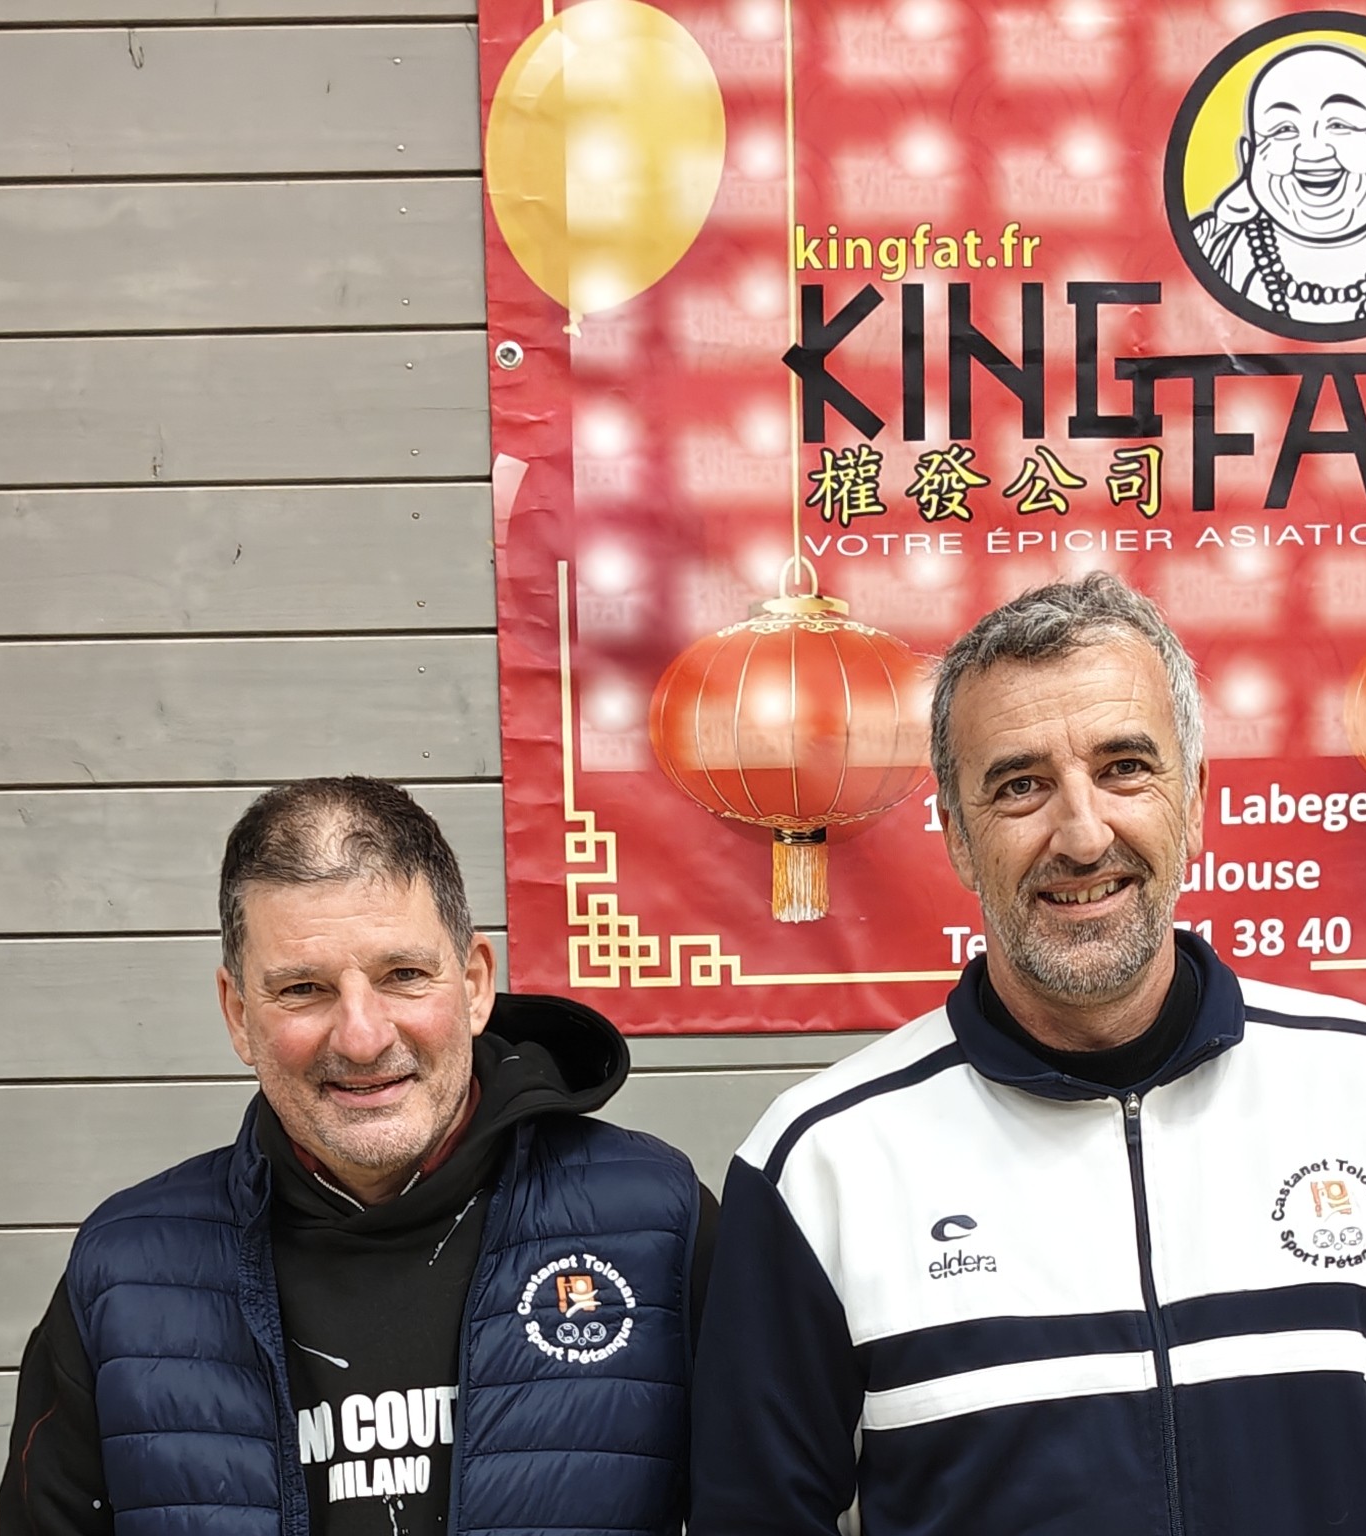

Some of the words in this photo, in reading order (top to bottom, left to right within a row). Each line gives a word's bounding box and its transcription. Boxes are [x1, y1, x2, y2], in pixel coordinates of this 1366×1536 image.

[794, 223, 1041, 281] kingfat.fr
[782, 282, 1161, 441] KING
[807, 445, 1164, 526] 權發公司
[805, 533, 963, 557] VOTRE
[987, 527, 1173, 555] ÉPICIER
[1180, 851, 1322, 893] ulouse
[942, 926, 988, 964] Te
[1232, 918, 1286, 957] 38
[1297, 917, 1352, 955] 40
[1271, 1159, 1330, 1222] Castanet
[928, 1249, 998, 1280] eldera
[1281, 1229, 1320, 1267] Sport
[517, 1254, 578, 1316] Castanet
[582, 1253, 636, 1309] Tolosan
[525, 1320, 565, 1361] Sport
[341, 1385, 459, 1454] COUT
